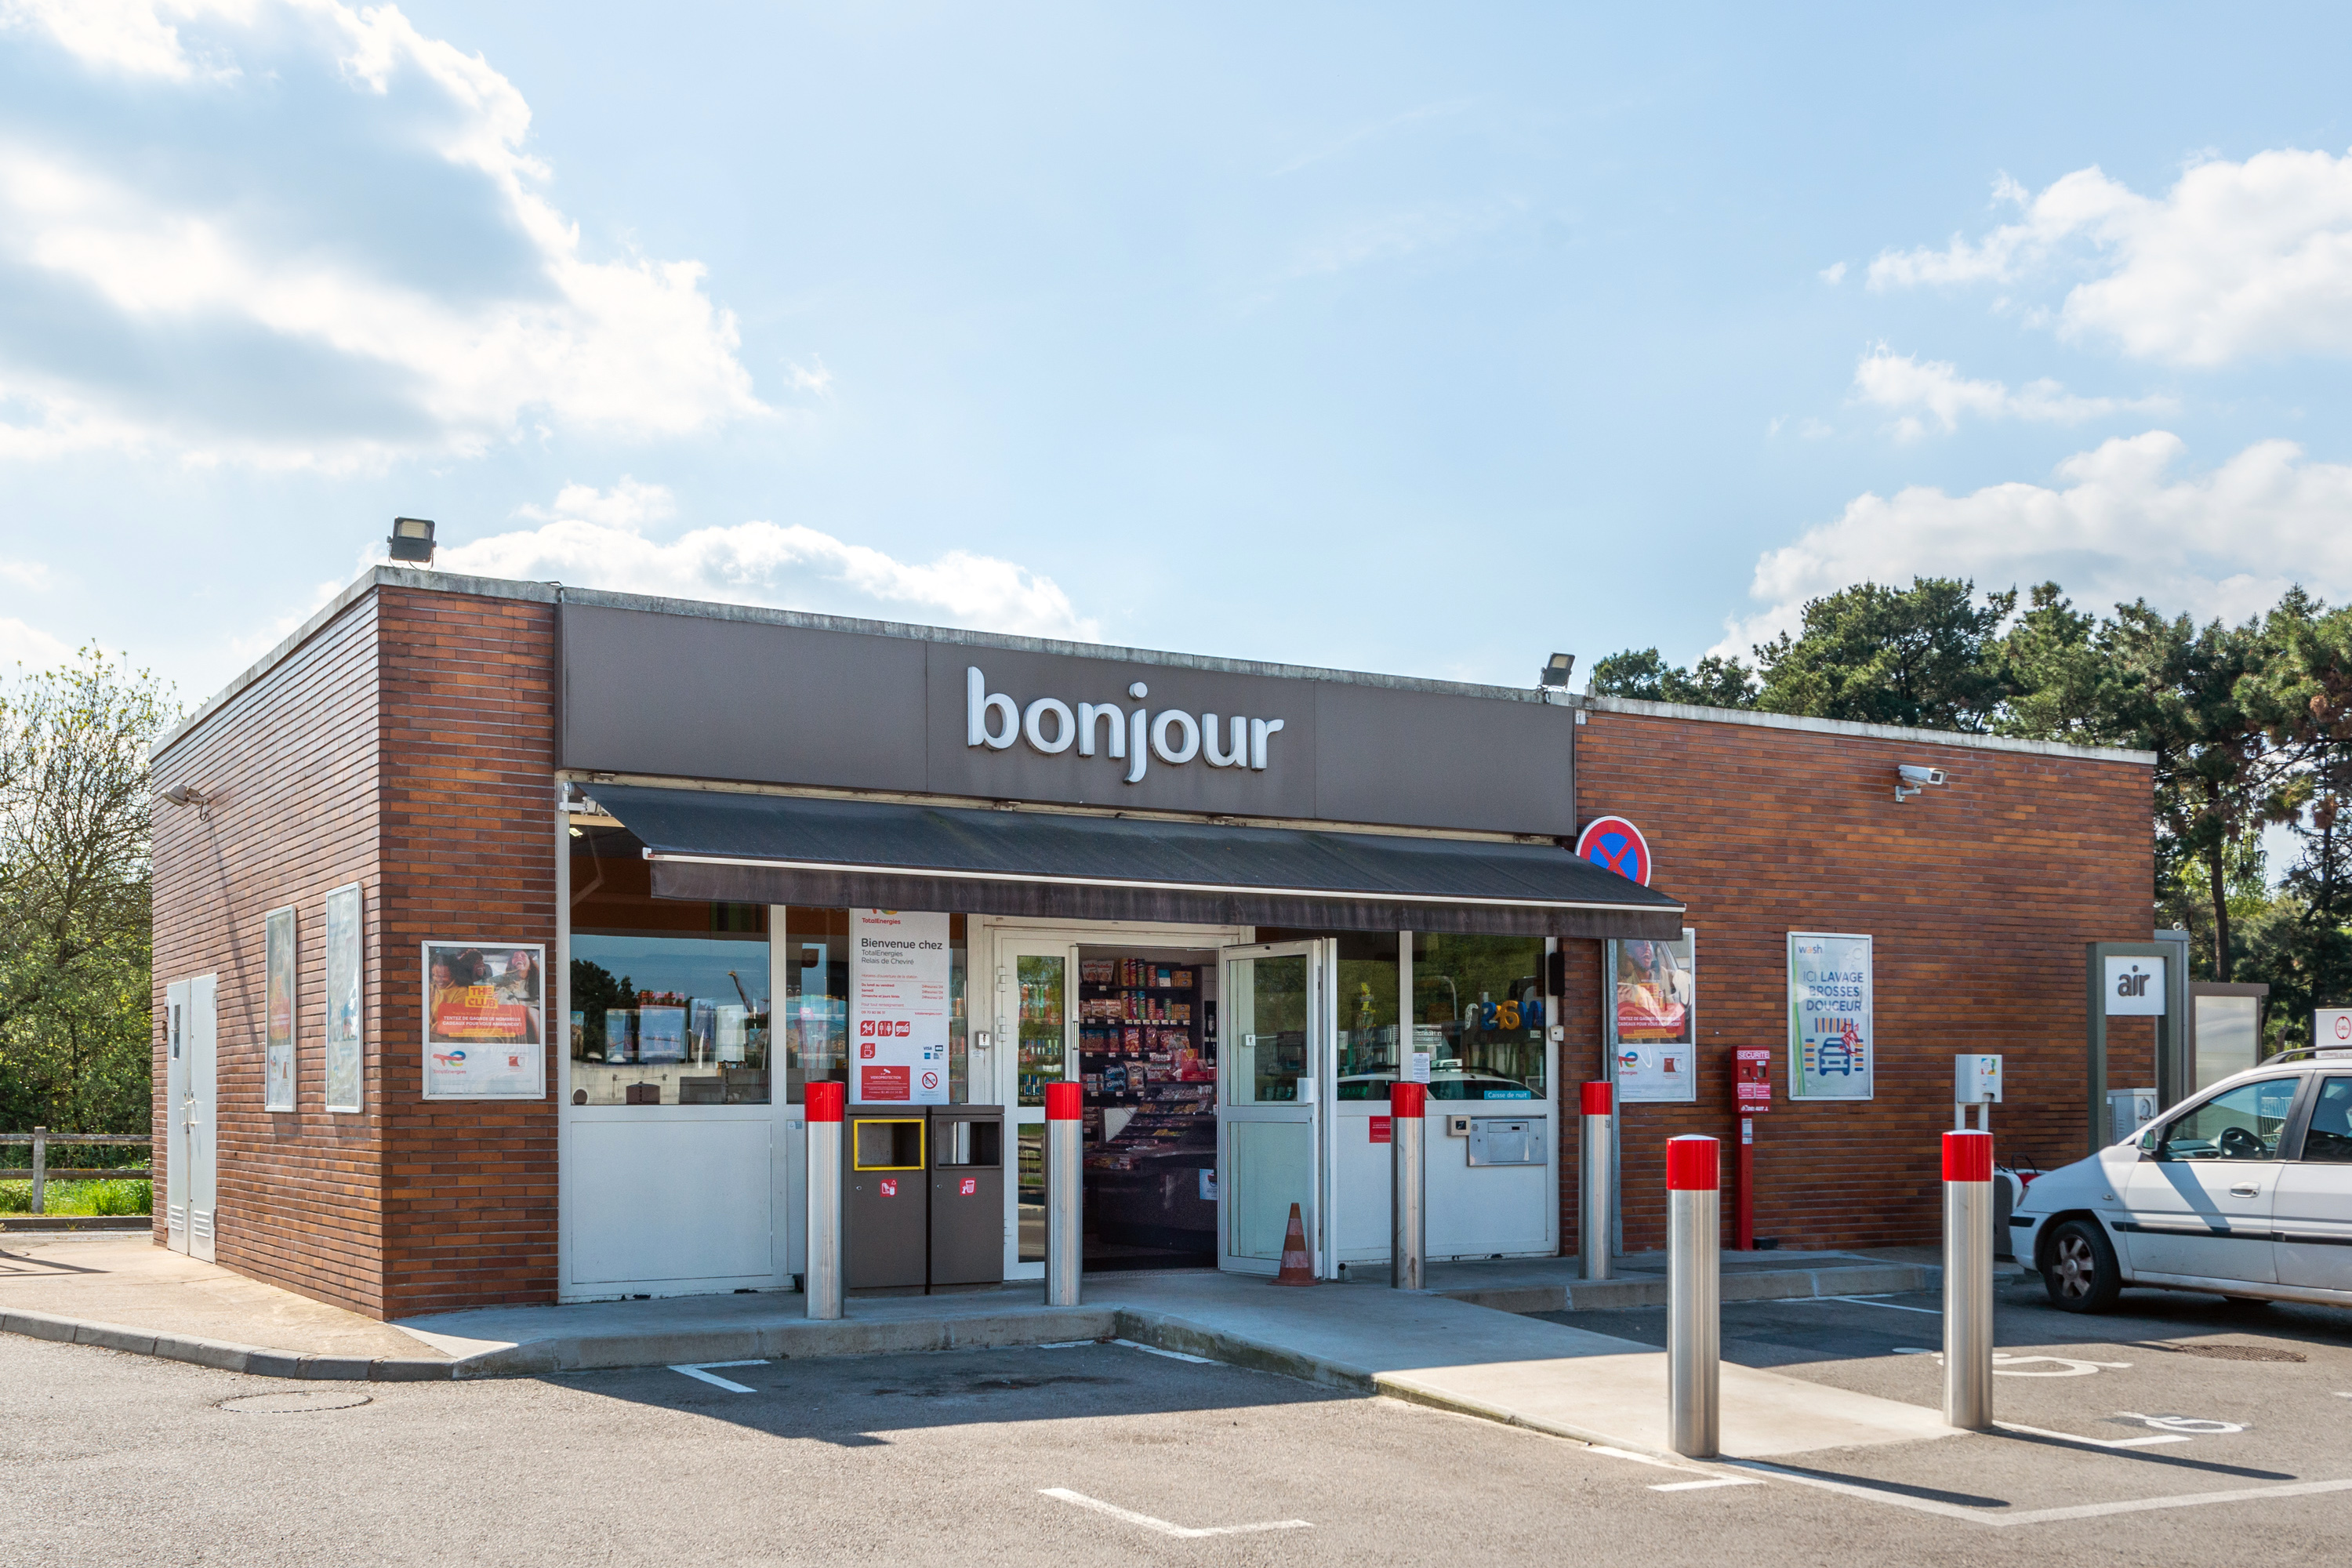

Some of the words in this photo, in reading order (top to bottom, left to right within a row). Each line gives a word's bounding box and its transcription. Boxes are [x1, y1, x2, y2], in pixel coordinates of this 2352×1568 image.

[967, 666, 1284, 783] bonjour
[861, 938, 916, 949] Bienvenue
[918, 940, 943, 950] chez
[1798, 944, 1823, 954] wash
[1803, 971, 1817, 982] ICI
[1820, 971, 1864, 983] LAVAGE
[2118, 965, 2151, 996] air
[470, 987, 492, 996] THE
[1809, 985, 1860, 997] BROSSES
[467, 998, 495, 1007] CLUB
[1806, 1000, 1861, 1011] DOUCEUR
